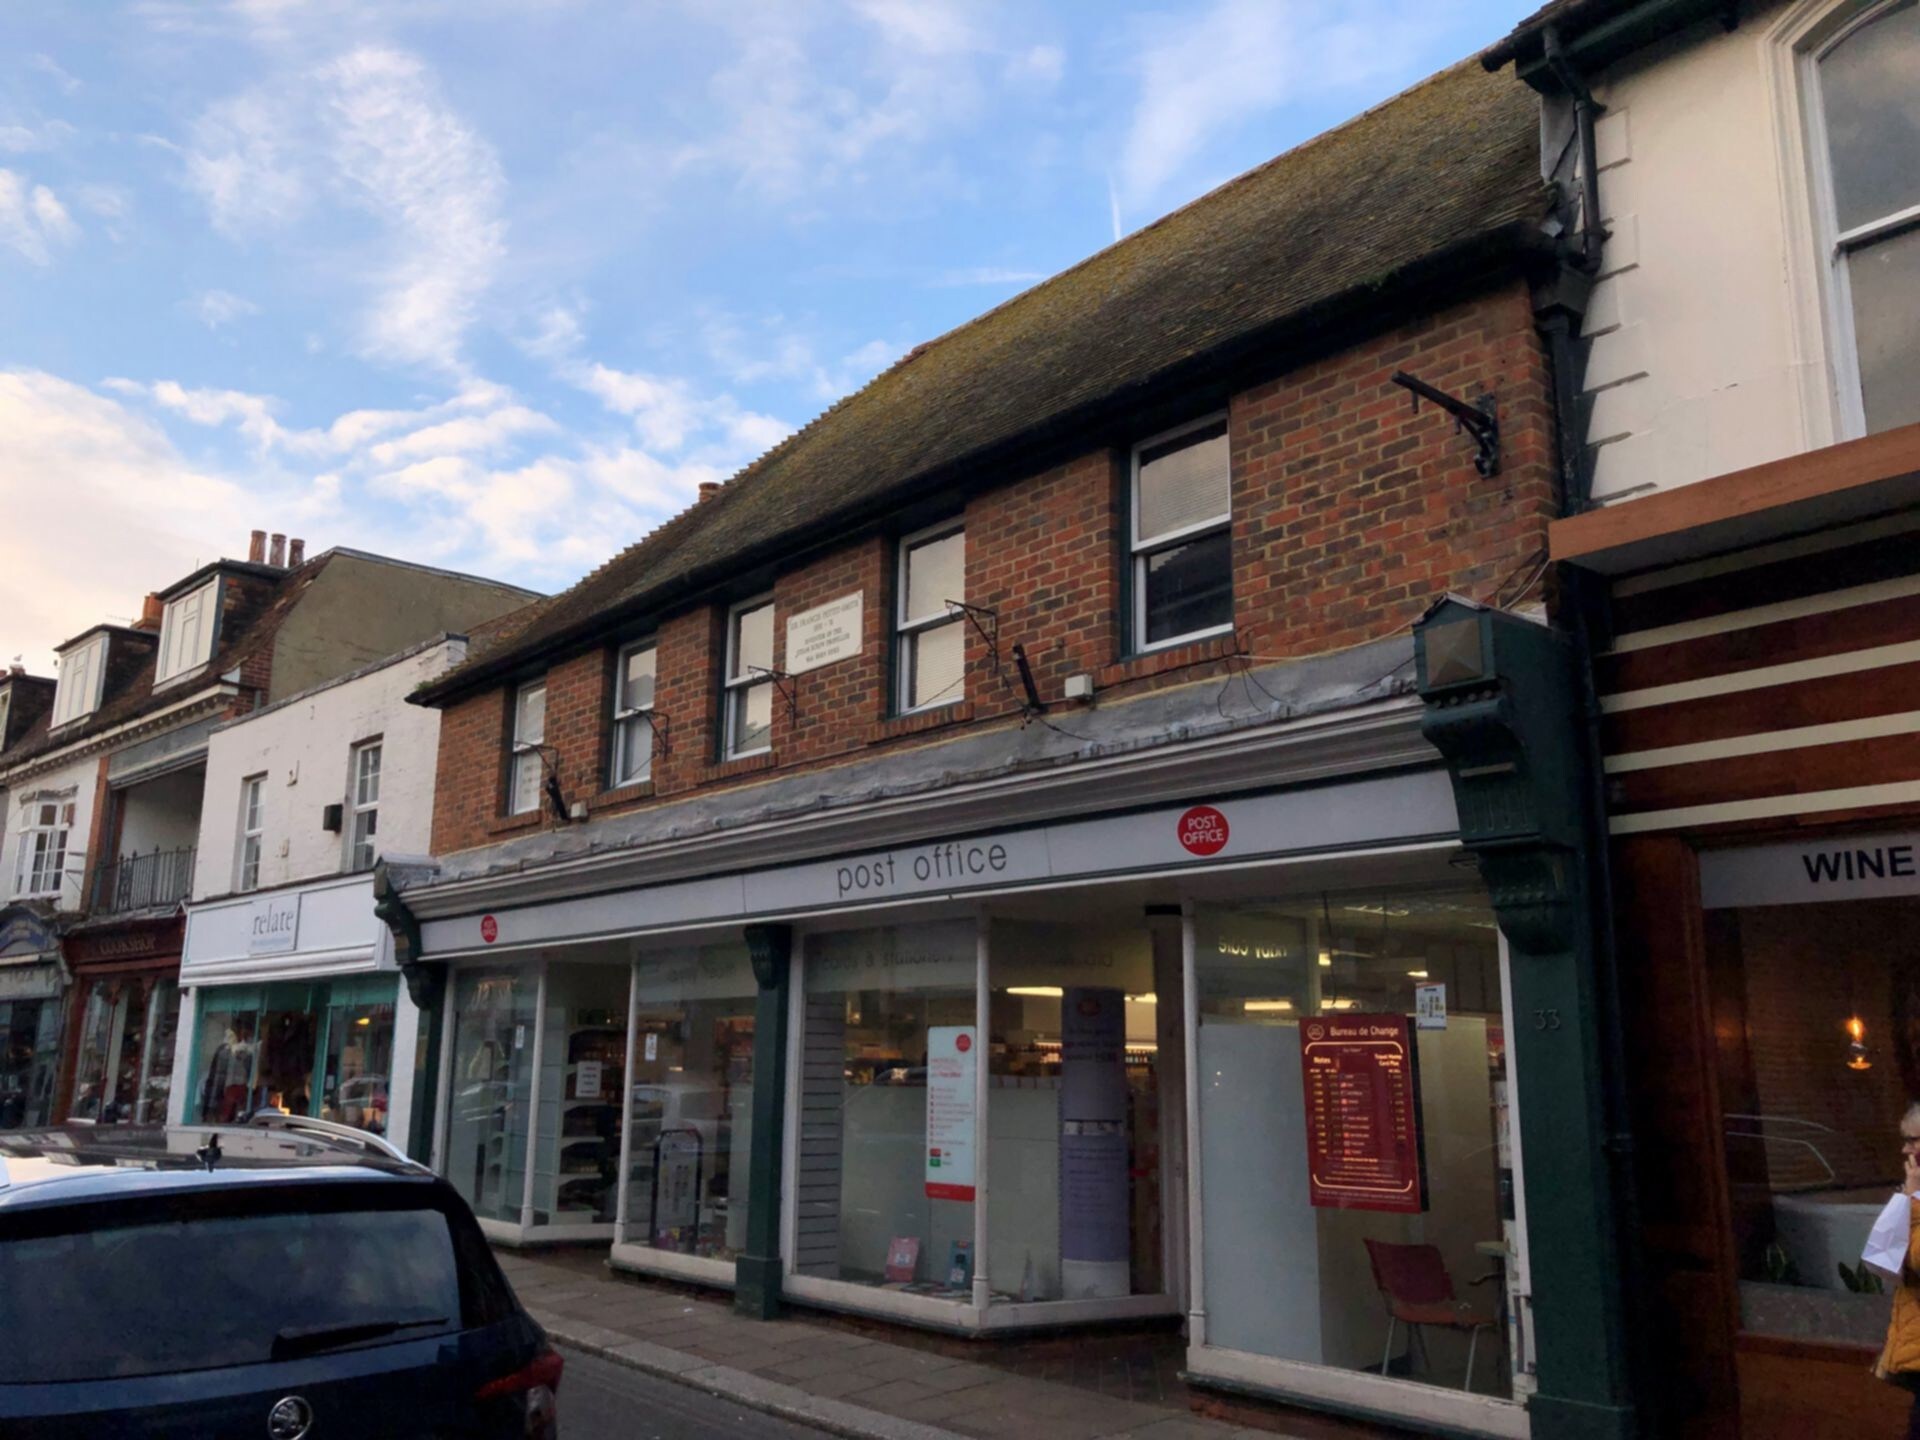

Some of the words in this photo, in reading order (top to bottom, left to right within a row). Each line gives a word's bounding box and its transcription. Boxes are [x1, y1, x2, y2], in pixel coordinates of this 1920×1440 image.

[1187, 815, 1217, 831] POST
[1183, 828, 1224, 845] OFFICE
[836, 853, 895, 898] post
[914, 844, 1007, 881] office
[1802, 845, 1917, 883] WINE
[252, 903, 294, 935] relate
[1534, 1009, 1560, 1029] 33
[1330, 1026, 1357, 1037] Bureau
[1359, 1027, 1369, 1036] de
[1370, 1025, 1399, 1038] Change
